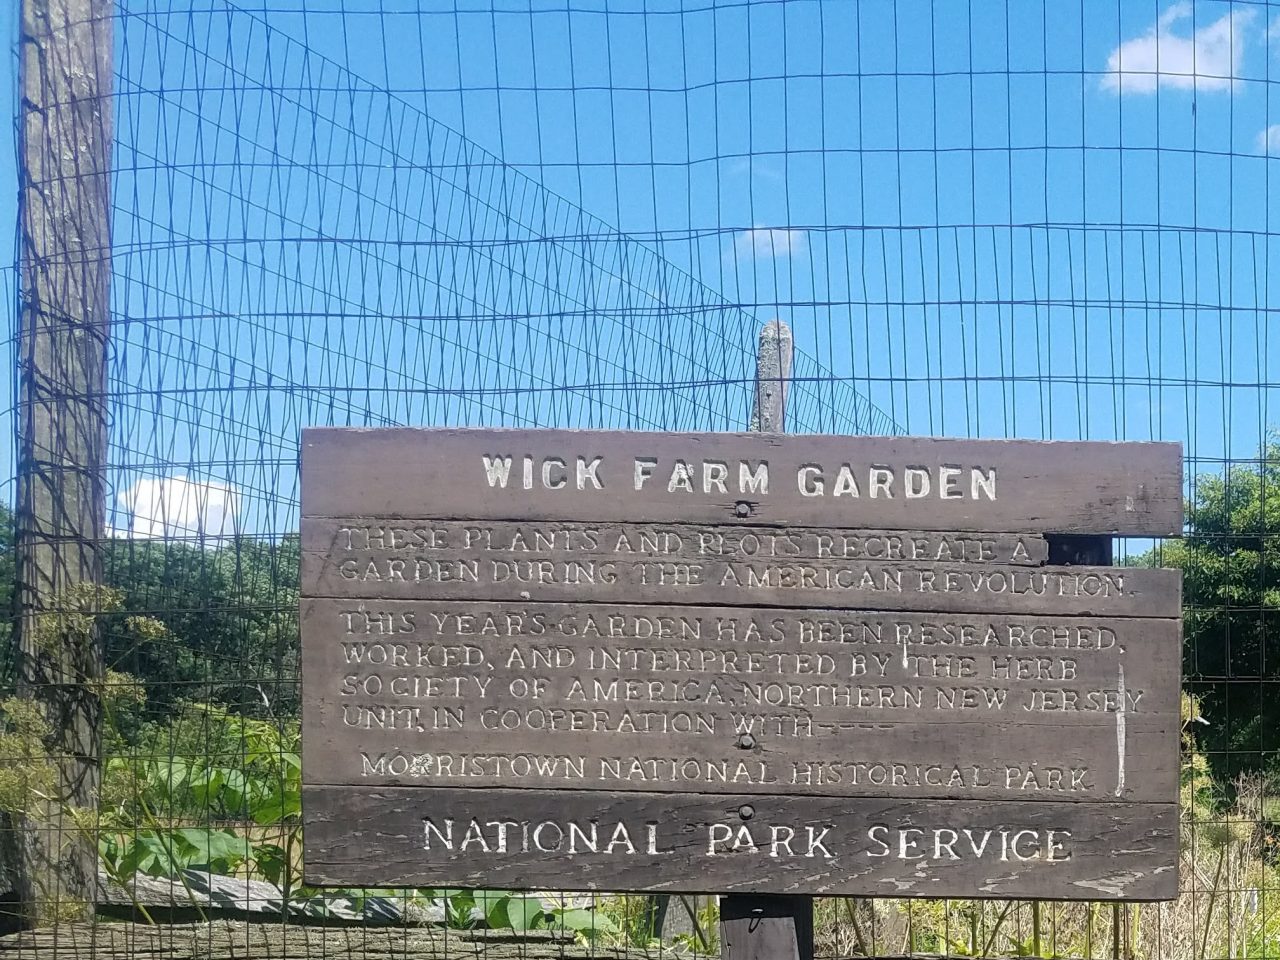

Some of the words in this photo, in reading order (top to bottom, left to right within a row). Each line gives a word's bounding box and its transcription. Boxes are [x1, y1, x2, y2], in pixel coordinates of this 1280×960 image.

[481, 453, 606, 492] WICK
[633, 456, 770, 496] FARM
[797, 460, 999, 501] GARDEN
[338, 526, 450, 551] THESE
[463, 527, 601, 554] PLANTS
[614, 529, 683, 554] AND
[698, 531, 801, 557] PLOTS
[816, 534, 999, 561] RECREATE
[1010, 537, 1031, 562] A
[338, 558, 480, 585] GARDEN
[491, 560, 621, 586] DURING
[632, 562, 704, 586] THE
[720, 562, 903, 592] AMERICAN
[918, 569, 1136, 598] REVOLUTION.
[339, 610, 416, 635] THIS
[558, 613, 702, 641] GARDEN
[716, 617, 786, 643] HAS
[799, 618, 882, 645] BEEN
[895, 622, 1127, 654] RESEARCHED,
[340, 641, 496, 671] WORKED,
[505, 645, 576, 669] AND
[588, 645, 836, 676] INTERPRETED
[850, 653, 893, 678] BY
[906, 655, 979, 679] THE
[990, 656, 1078, 681] HERB
[340, 673, 493, 699] SOCIETY
[509, 677, 552, 700] OF
[566, 676, 736, 706] AMERICA,
[742, 681, 924, 709] NORTHERN
[936, 687, 1009, 711] NEW
[1022, 687, 1145, 714] JERSEY
[342, 703, 425, 732] UNIT,
[432, 705, 466, 729] IN
[480, 708, 717, 735] COOPERATION
[360, 751, 587, 780] MORRISTOWN
[599, 756, 777, 785] NATIONAL
[791, 761, 990, 789] HISTORICAL
[1004, 763, 1095, 792] PARK
[421, 817, 674, 856] NATIONAL
[706, 822, 838, 859] PARK
[866, 825, 1072, 863] SERVICE
